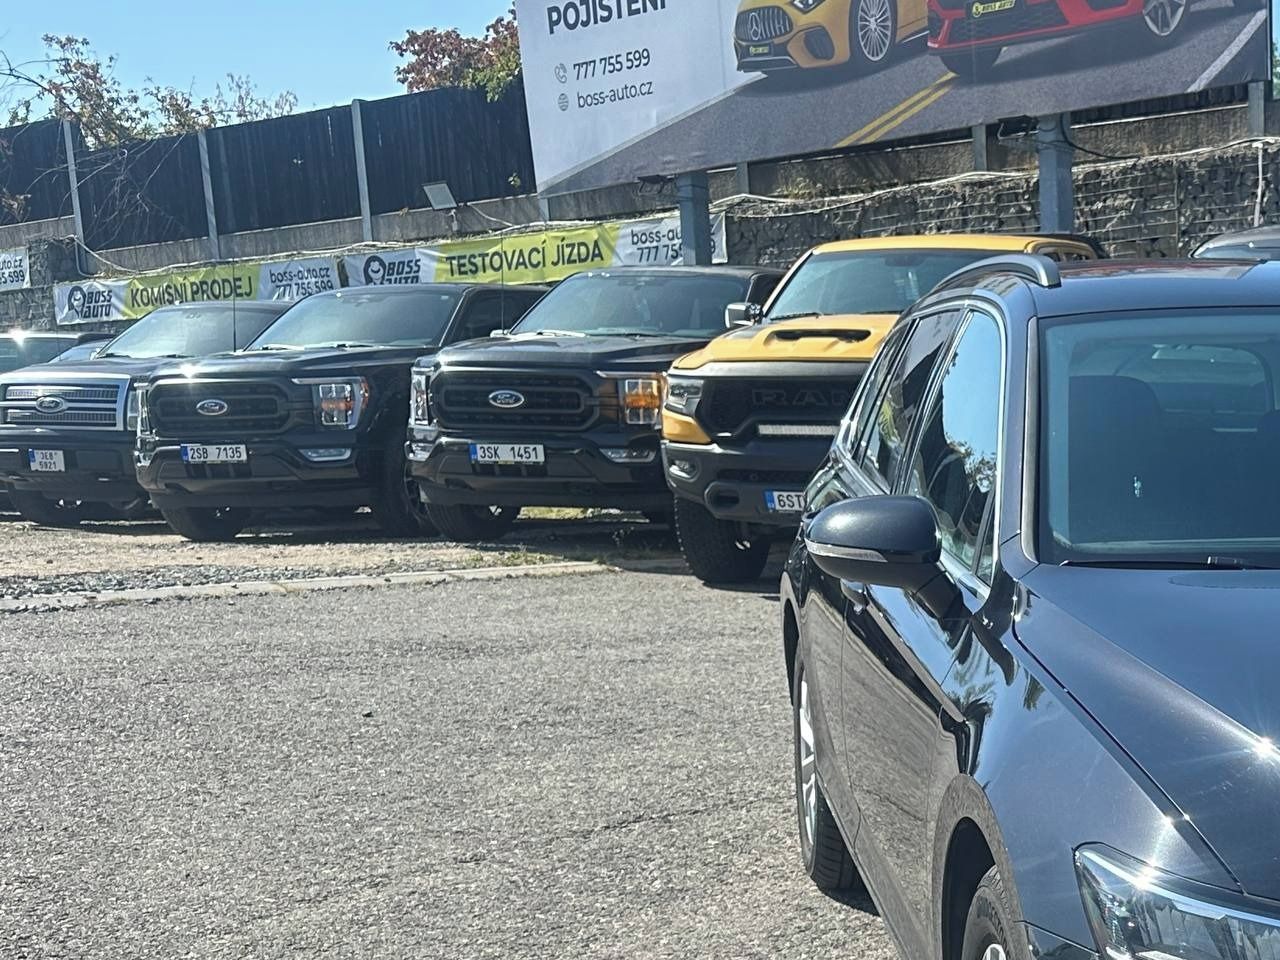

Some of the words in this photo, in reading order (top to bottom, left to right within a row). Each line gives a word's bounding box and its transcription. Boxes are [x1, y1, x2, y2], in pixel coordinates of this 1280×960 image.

[573, 60, 596, 80] 777
[600, 54, 623, 75] 755
[626, 48, 651, 70] 599
[577, 81, 653, 108] boss-auto.cz
[446, 240, 546, 277] TESTOVACÍ
[551, 237, 604, 267] JÍZDA
[637, 246, 659, 262] 777
[269, 266, 331, 284] boss-auto.cz
[386, 258, 421, 276] BOSS
[8, 270, 25, 283] 599
[131, 276, 188, 308] KOMISNÍ
[191, 276, 252, 303] PRODEJ
[314, 279, 334, 294] 599
[87, 290, 113, 304] BOSS
[83, 304, 112, 318] AUTO
[190, 447, 209, 460] 2SB
[215, 446, 242, 459] 7135
[480, 446, 501, 460] 3SK
[510, 446, 539, 460] 1451
